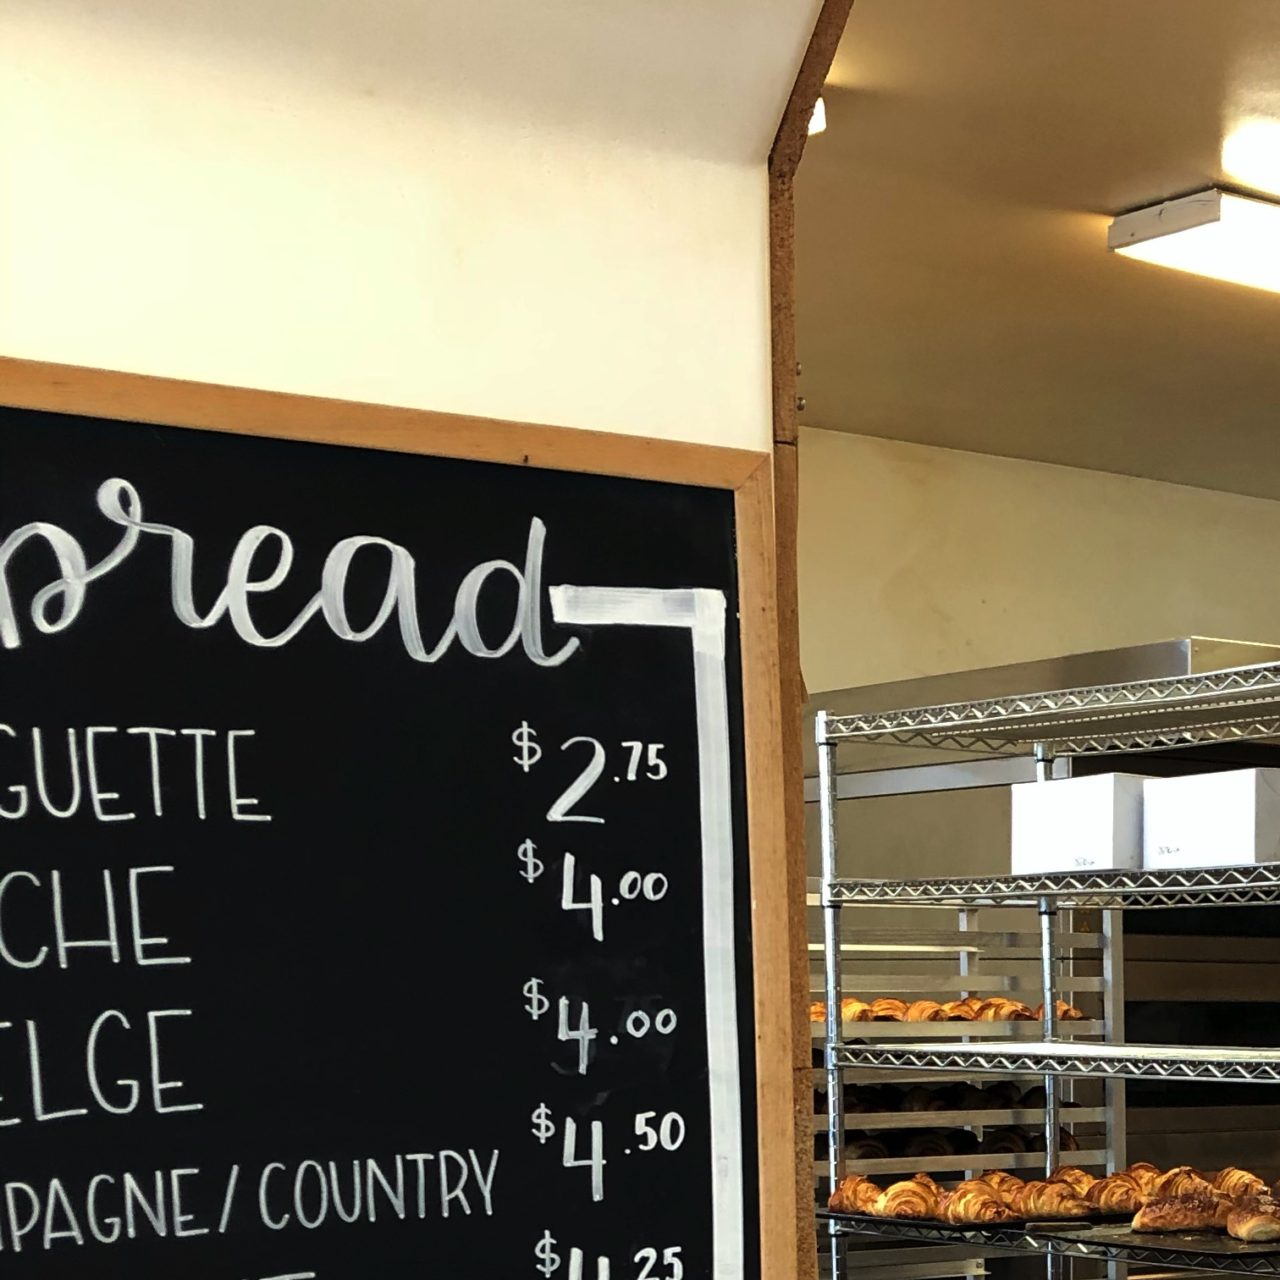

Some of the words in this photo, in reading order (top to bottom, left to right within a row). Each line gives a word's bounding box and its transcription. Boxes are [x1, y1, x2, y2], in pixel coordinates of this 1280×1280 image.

[512, 721, 668, 822] $2.75
[517, 838, 668, 941] $4.00
[523, 977, 677, 1074] $4.00
[0, 1148, 500, 1252] PAGNE/COUNTRY
[531, 1102, 686, 1201] $4.50
